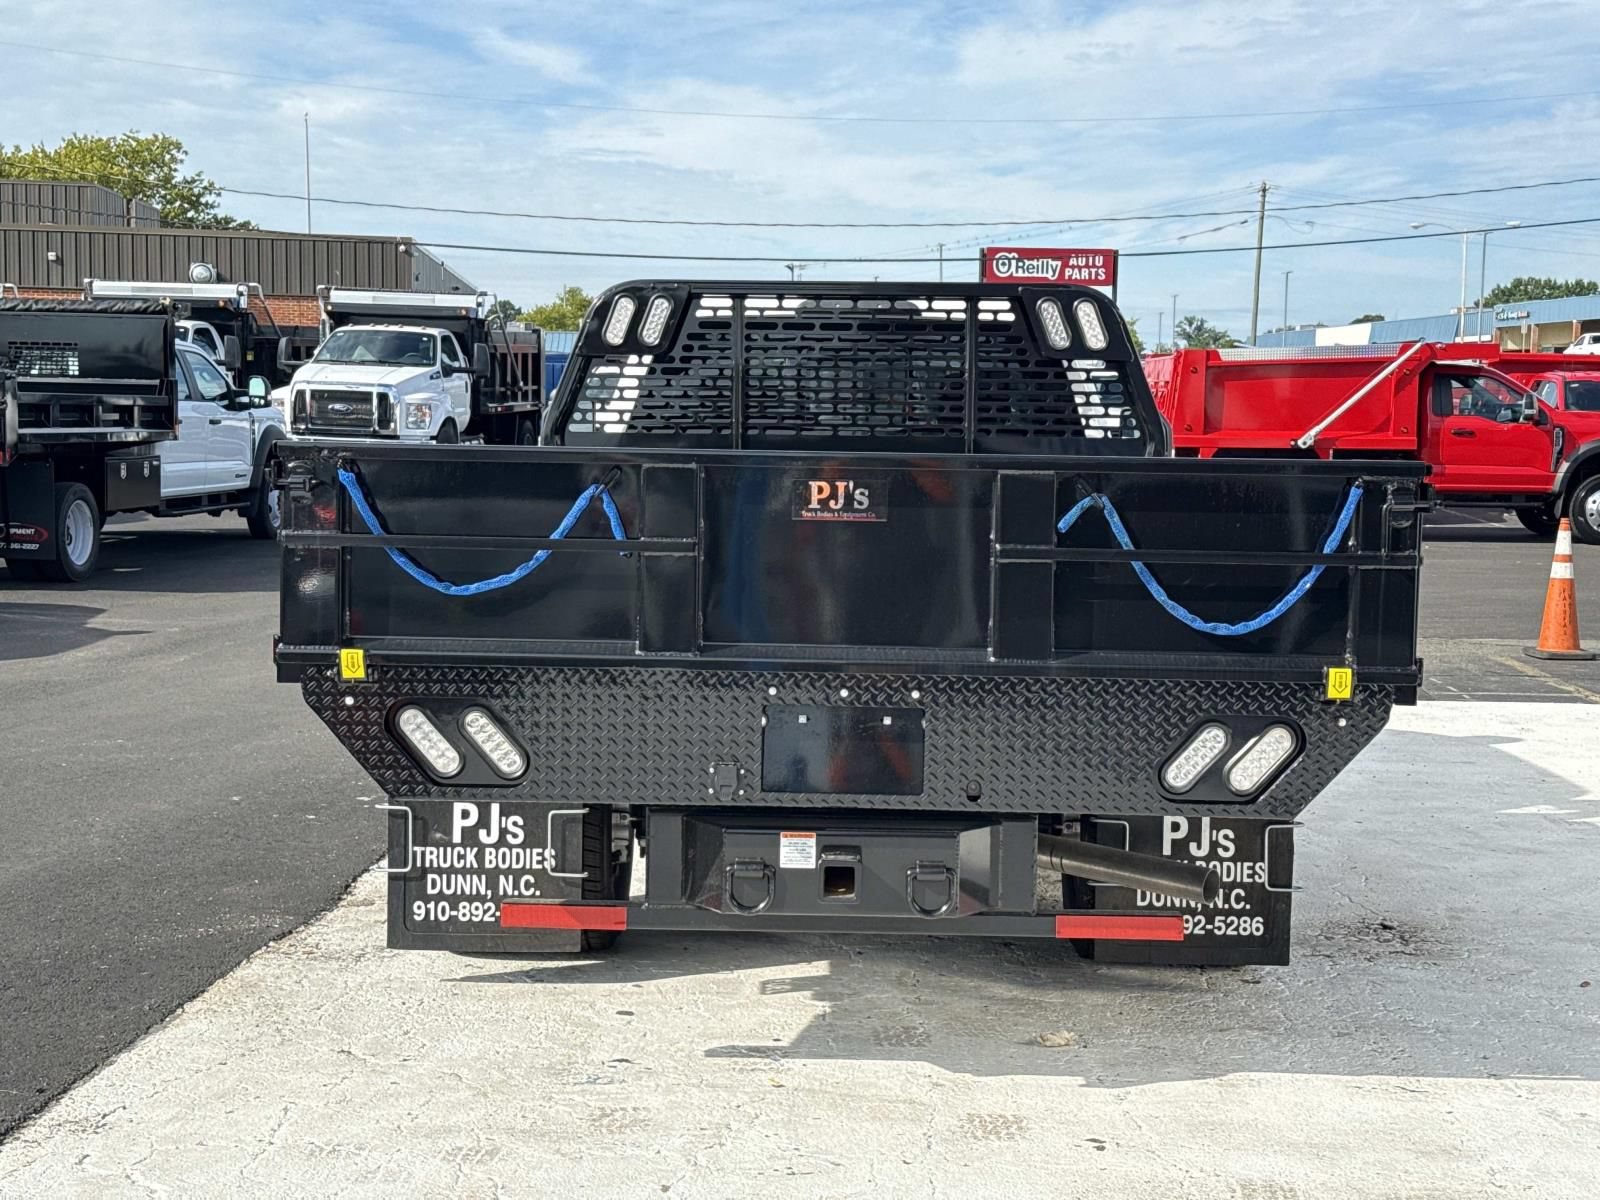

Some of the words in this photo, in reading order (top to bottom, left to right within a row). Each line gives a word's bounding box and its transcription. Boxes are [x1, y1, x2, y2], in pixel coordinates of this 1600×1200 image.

[994, 253, 1060, 279] O'Reilly
[1069, 255, 1103, 266] AUTO
[1065, 268, 1106, 280] PARTS
[808, 480, 869, 509] PJ's
[413, 847, 478, 868] TRUCK
[485, 848, 556, 869] BODIES
[427, 874, 491, 899] DUNN,
[499, 875, 541, 896] N.C.
[413, 901, 501, 922] 910-892-
[1183, 915, 1264, 936] 92-5286
